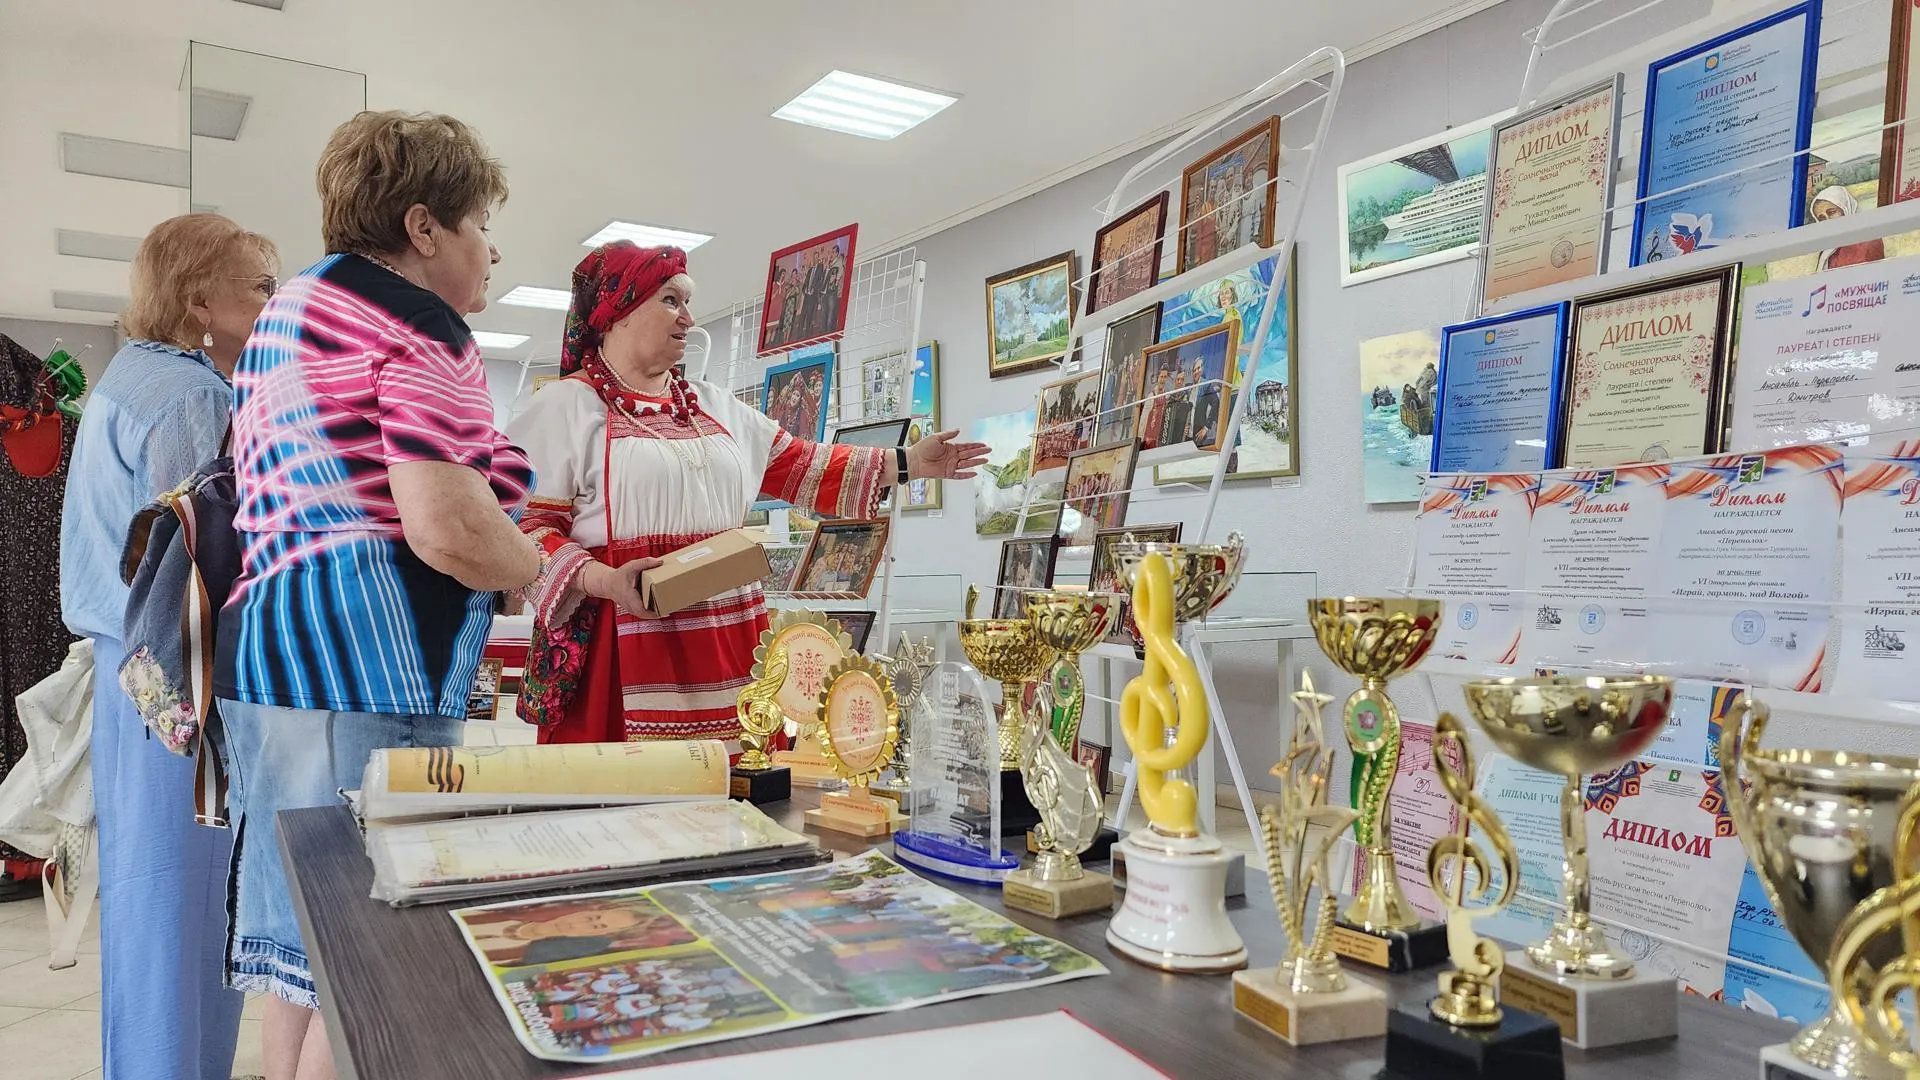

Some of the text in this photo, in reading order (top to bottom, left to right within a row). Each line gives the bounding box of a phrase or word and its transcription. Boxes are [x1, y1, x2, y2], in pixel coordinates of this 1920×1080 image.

[1695, 72, 1757, 103] ДИПЛОМ
[1515, 120, 1590, 167] ДИПЛОМ
[1835, 280, 1889, 299] «МУЖЧИН
[1600, 312, 1692, 351] ДИПЛОМ
[1777, 340, 1825, 355] ЛАУРЕАТ
[1476, 356, 1523, 373] ДИПЛОМ
[1603, 353, 1682, 371] Солнечногорская
[1629, 366, 1654, 376] весна
[1606, 380, 1639, 392] Лауреата
[1788, 389, 1831, 404] Дмитров
[1569, 495, 1630, 514] Диплом
[1709, 485, 1787, 507] Диплом
[1450, 503, 1499, 520] Диплом
[1713, 509, 1782, 518] НАГРАЖДАЕТСЯ
[1736, 528, 1768, 536] русской
[1895, 572, 1912, 581] VII
[1706, 590, 1747, 598] гармонь,
[1749, 590, 1767, 598] над
[1768, 590, 1809, 600] Волгой»
[1864, 607, 1908, 617] «Играй,
[1603, 817, 1713, 859] ДИПЛОМ
